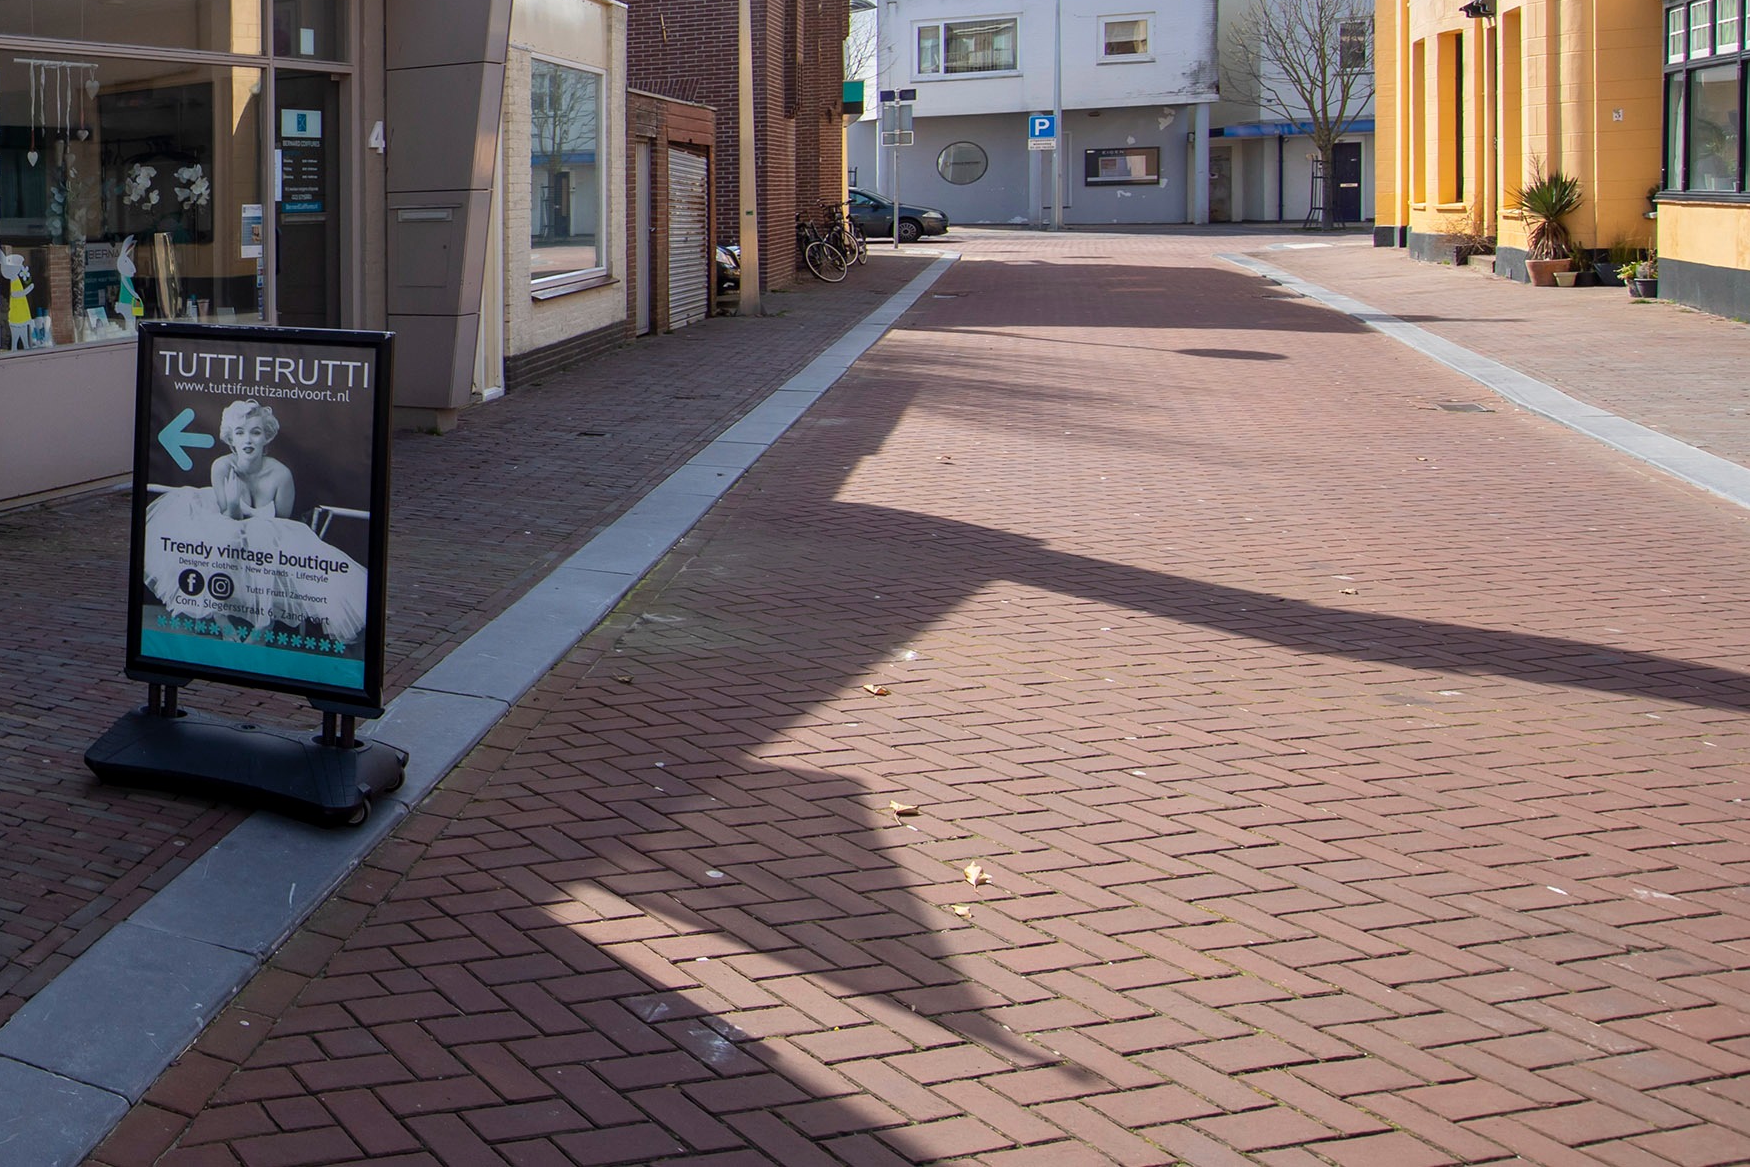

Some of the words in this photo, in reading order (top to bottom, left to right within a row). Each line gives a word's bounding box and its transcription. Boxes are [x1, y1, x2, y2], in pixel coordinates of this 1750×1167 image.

[369, 121, 386, 154] 4
[1034, 118, 1050, 135] P
[88, 248, 120, 260] BERNA
[158, 350, 244, 381] TUTTI
[255, 356, 369, 389] FRUTTI
[174, 380, 350, 403] www.tuttifruttizandvoort.nl
[160, 536, 214, 560] Trendy
[217, 544, 274, 566] vintage
[278, 550, 350, 575] boutique
[178, 557, 210, 569] Designer
[211, 560, 239, 571] clothes
[245, 565, 262, 574] New
[263, 567, 289, 578] brands
[295, 571, 329, 584] Lifestyle
[245, 585, 265, 596] Tutti
[266, 588, 288, 599] Frutti
[289, 591, 328, 604] Zandvoort
[175, 595, 200, 608] Corn.
[203, 598, 265, 617] Slegersstraat
[280, 610, 330, 626] Zandvoort
